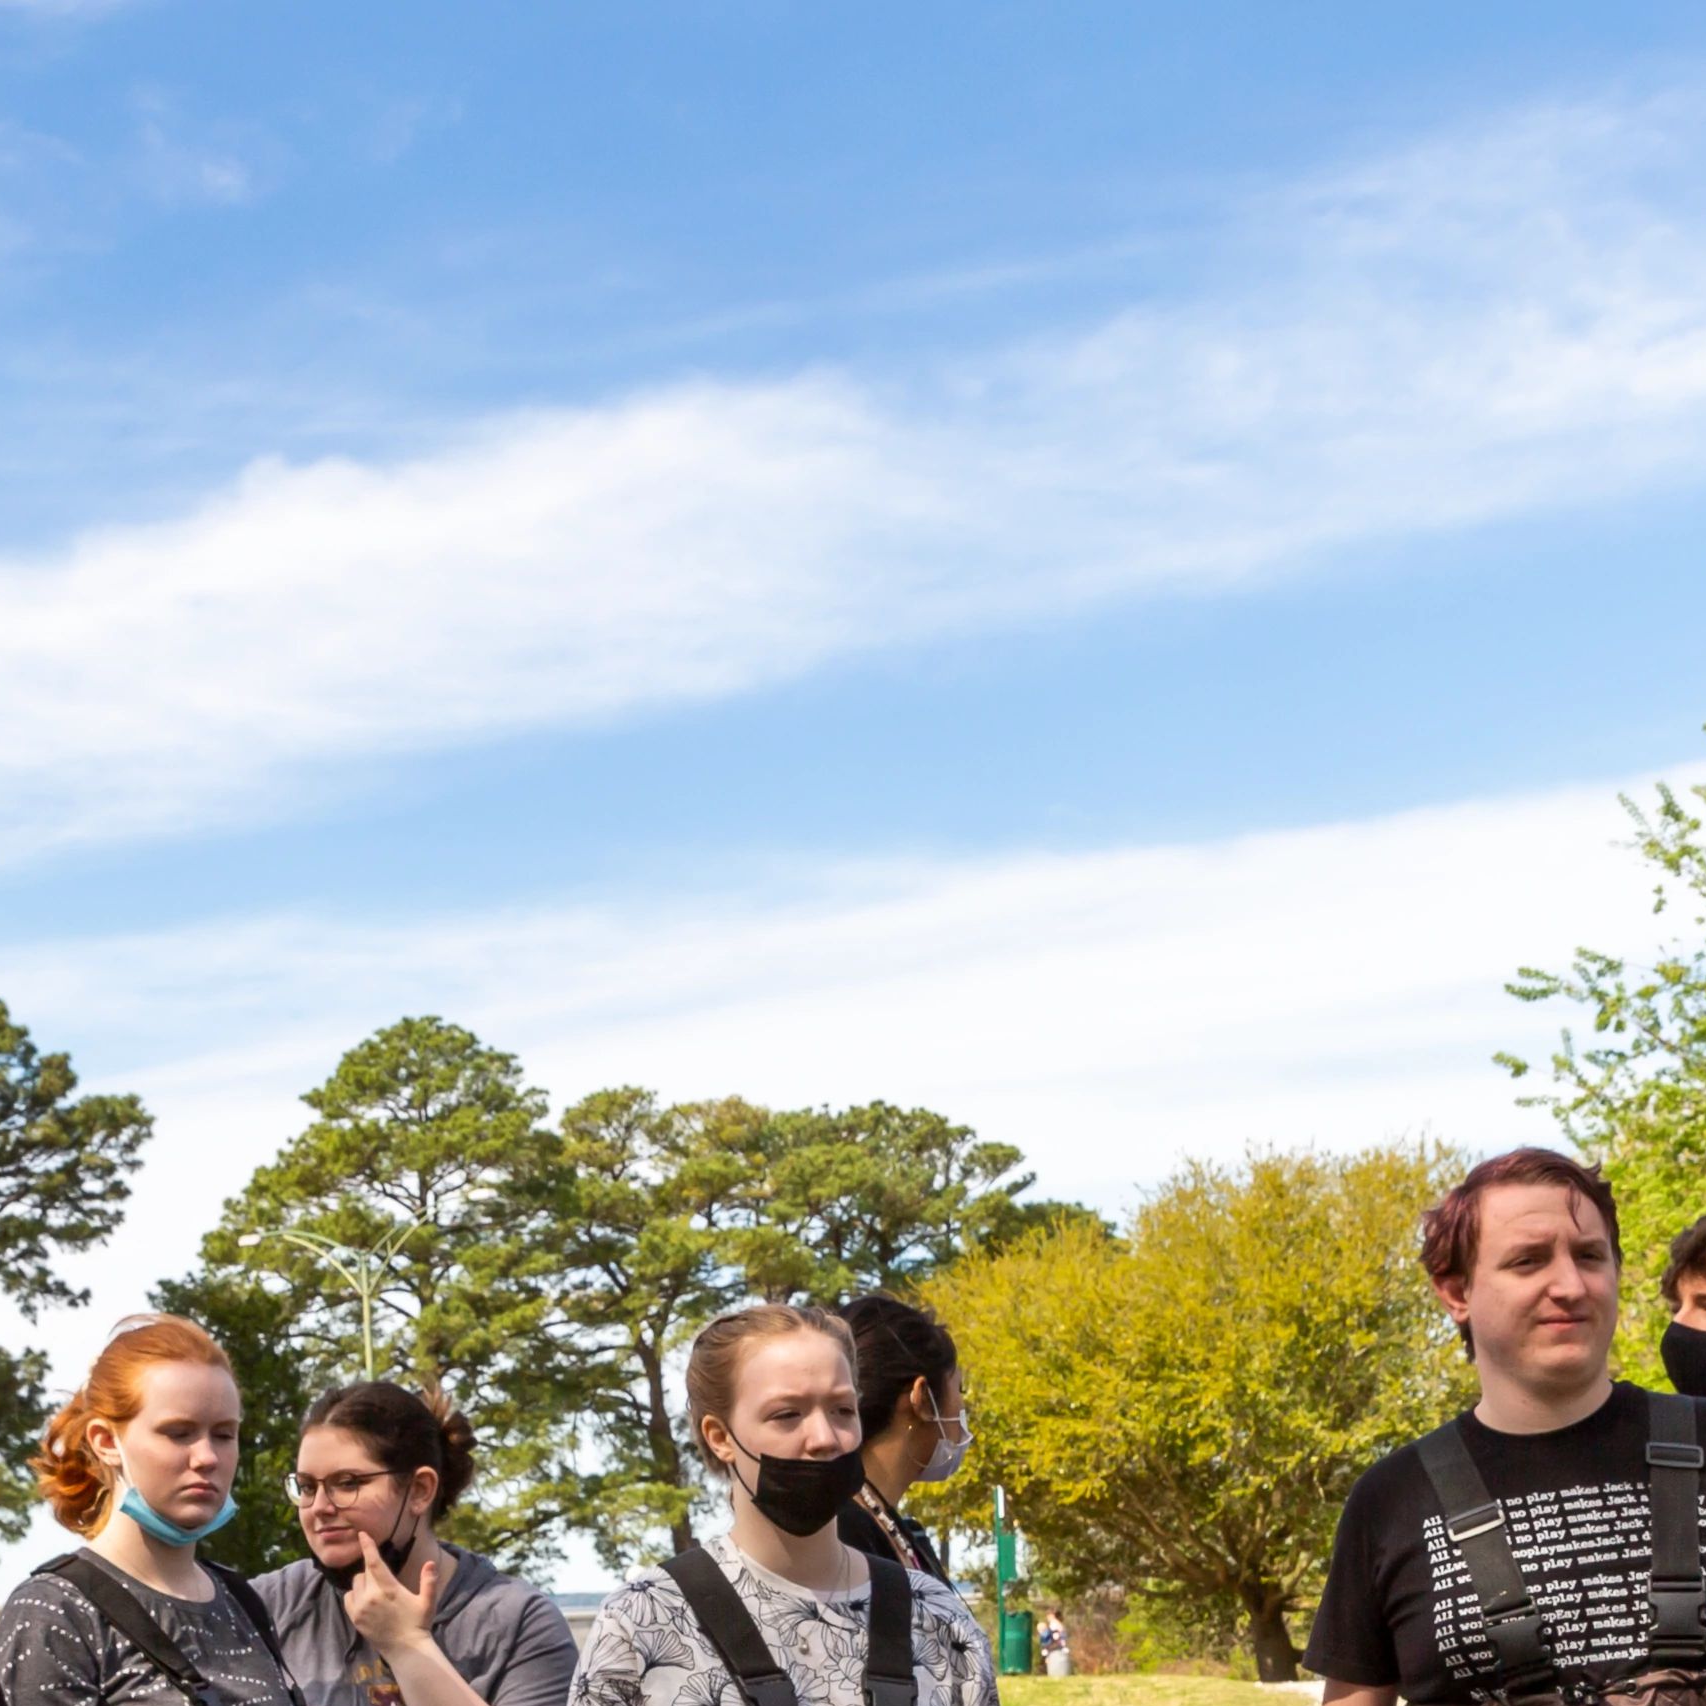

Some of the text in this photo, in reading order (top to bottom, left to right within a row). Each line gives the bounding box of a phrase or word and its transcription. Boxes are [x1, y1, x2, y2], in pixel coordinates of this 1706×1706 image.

[1423, 1515, 1443, 1529] All
[1506, 1496, 1522, 1506] no
[1526, 1491, 1555, 1505] play
[1560, 1485, 1599, 1498] makes
[1603, 1481, 1633, 1493] Jack
[1424, 1526, 1445, 1539] All
[1509, 1509, 1526, 1519] no
[1530, 1504, 1559, 1518] play
[1564, 1498, 1603, 1511] makes
[1606, 1494, 1637, 1506] Jack
[1427, 1537, 1448, 1552] All
[1513, 1521, 1530, 1532] no
[1533, 1516, 1563, 1530] play
[1621, 1506, 1651, 1517] Jack
[1430, 1550, 1450, 1564] All
[1515, 1534, 1533, 1544] no
[1536, 1528, 1566, 1542] play
[1570, 1522, 1610, 1536] makes
[1614, 1518, 1645, 1530] Jack
[1433, 1578, 1454, 1592] All
[1521, 1562, 1539, 1572] no
[1543, 1558, 1573, 1572] play
[1577, 1551, 1618, 1564] makes
[1621, 1546, 1653, 1558] Jack
[1433, 1598, 1453, 1612] All
[1546, 1579, 1577, 1593] play
[1582, 1574, 1623, 1586] makes
[1434, 1610, 1453, 1624] All
[1588, 1587, 1628, 1599] makes
[1435, 1624, 1455, 1639] All
[1585, 1604, 1627, 1616] makes
[1438, 1637, 1459, 1652] All
[1557, 1622, 1587, 1636] play
[1593, 1616, 1634, 1629] makes
[1445, 1654, 1465, 1667] All
[1555, 1638, 1585, 1652] play
[1591, 1634, 1633, 1646] makes
